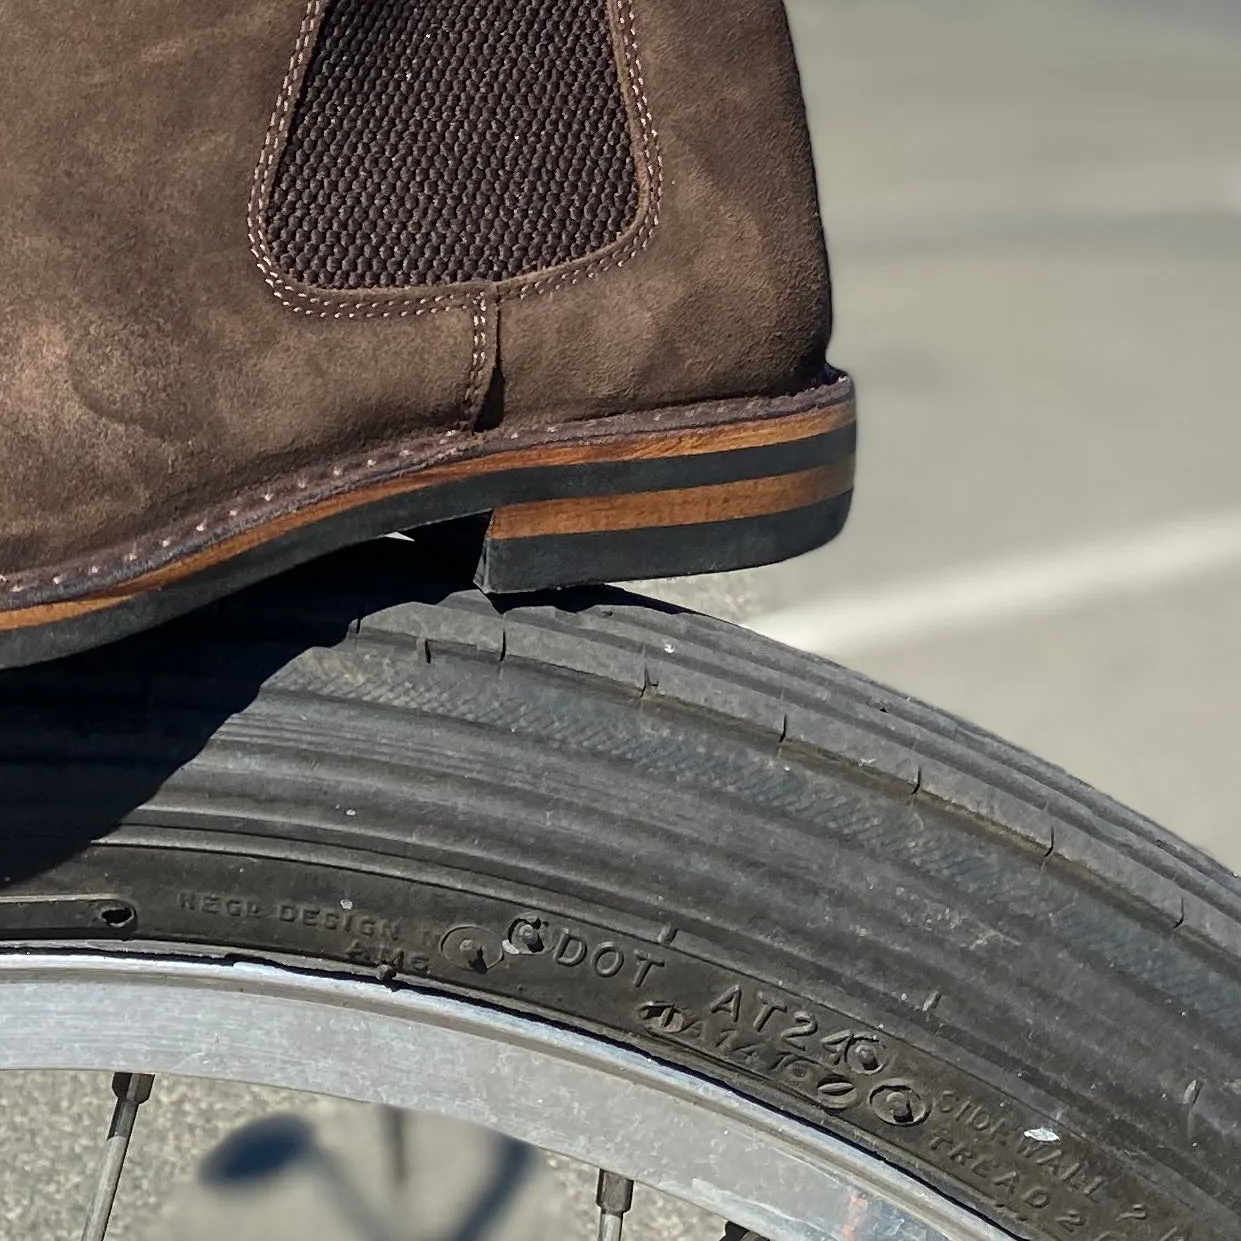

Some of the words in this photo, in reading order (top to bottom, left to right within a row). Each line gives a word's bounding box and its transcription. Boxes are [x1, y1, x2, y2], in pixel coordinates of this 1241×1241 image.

[276, 902, 403, 943] DESIGN
[553, 927, 665, 988] DOT
[928, 1126, 1052, 1209] TREAD
